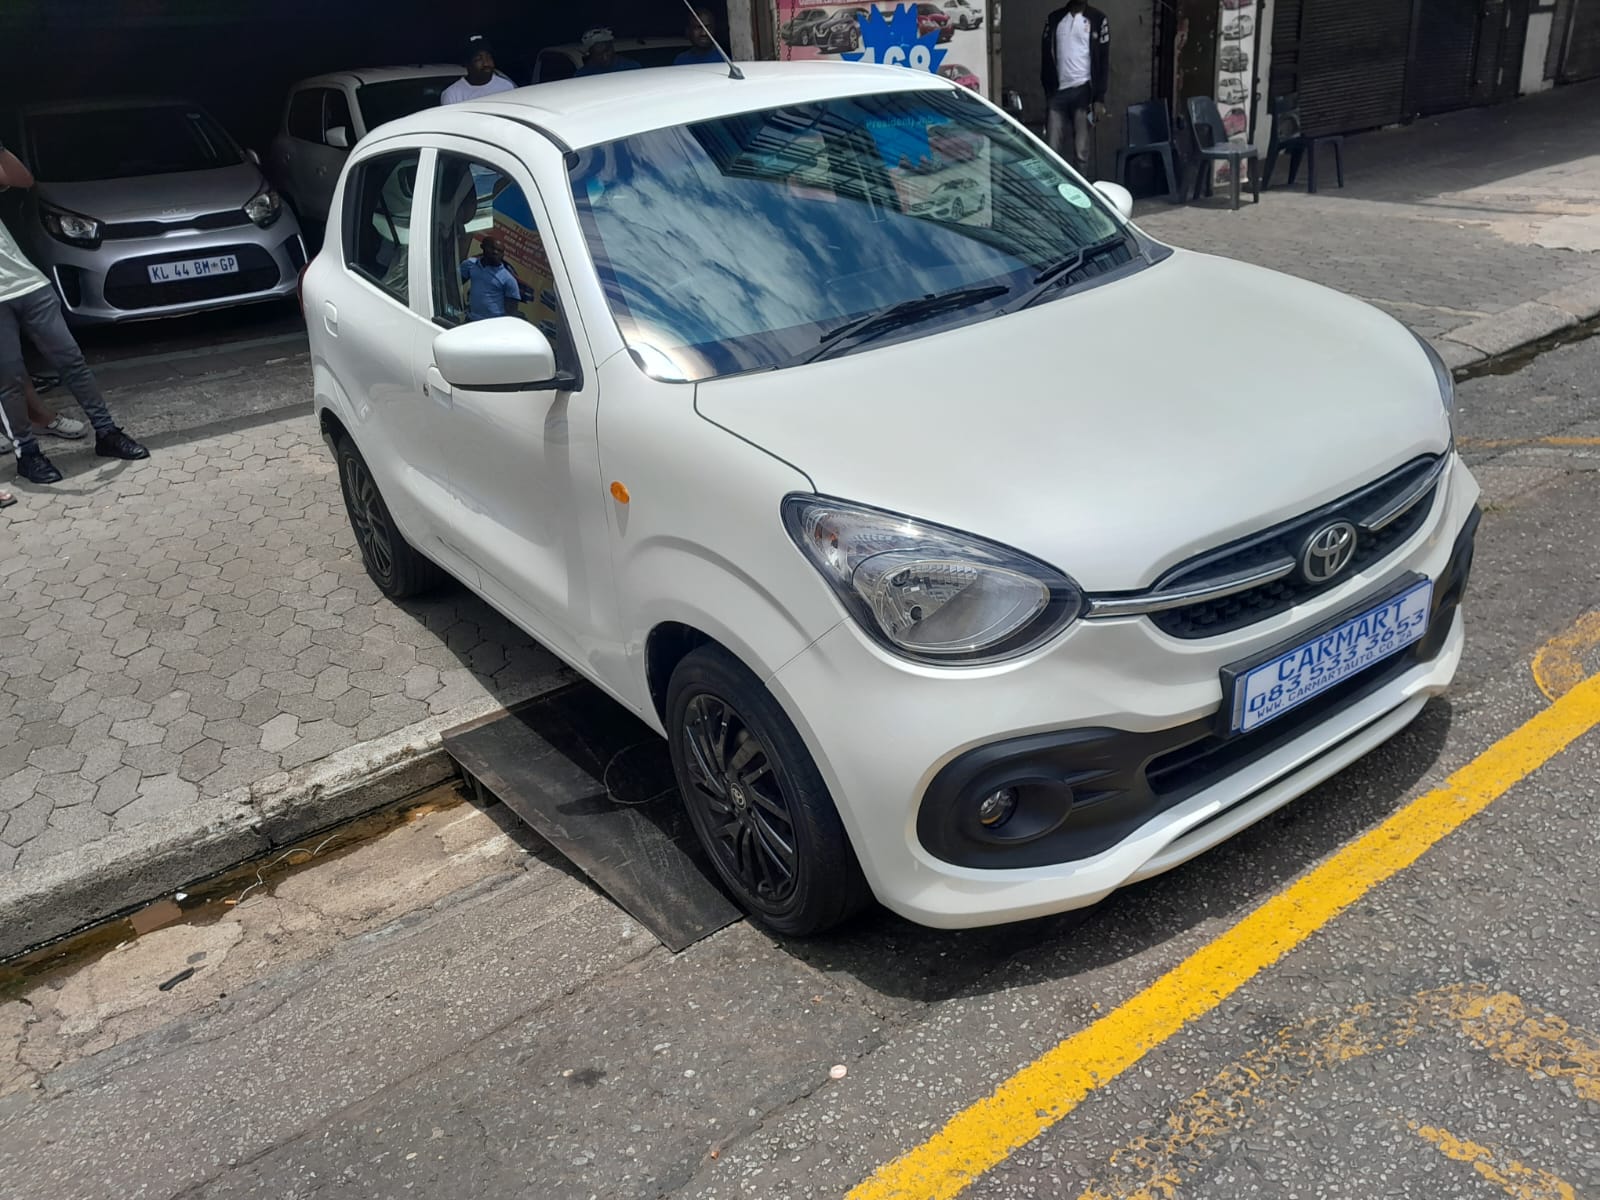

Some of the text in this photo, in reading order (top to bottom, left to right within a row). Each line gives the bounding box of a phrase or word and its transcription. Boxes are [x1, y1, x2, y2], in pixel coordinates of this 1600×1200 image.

[152, 258, 234, 280] KL 44 BM GP
[1249, 609, 1425, 713] 083 533 3653
[1278, 600, 1406, 681] CARMART
